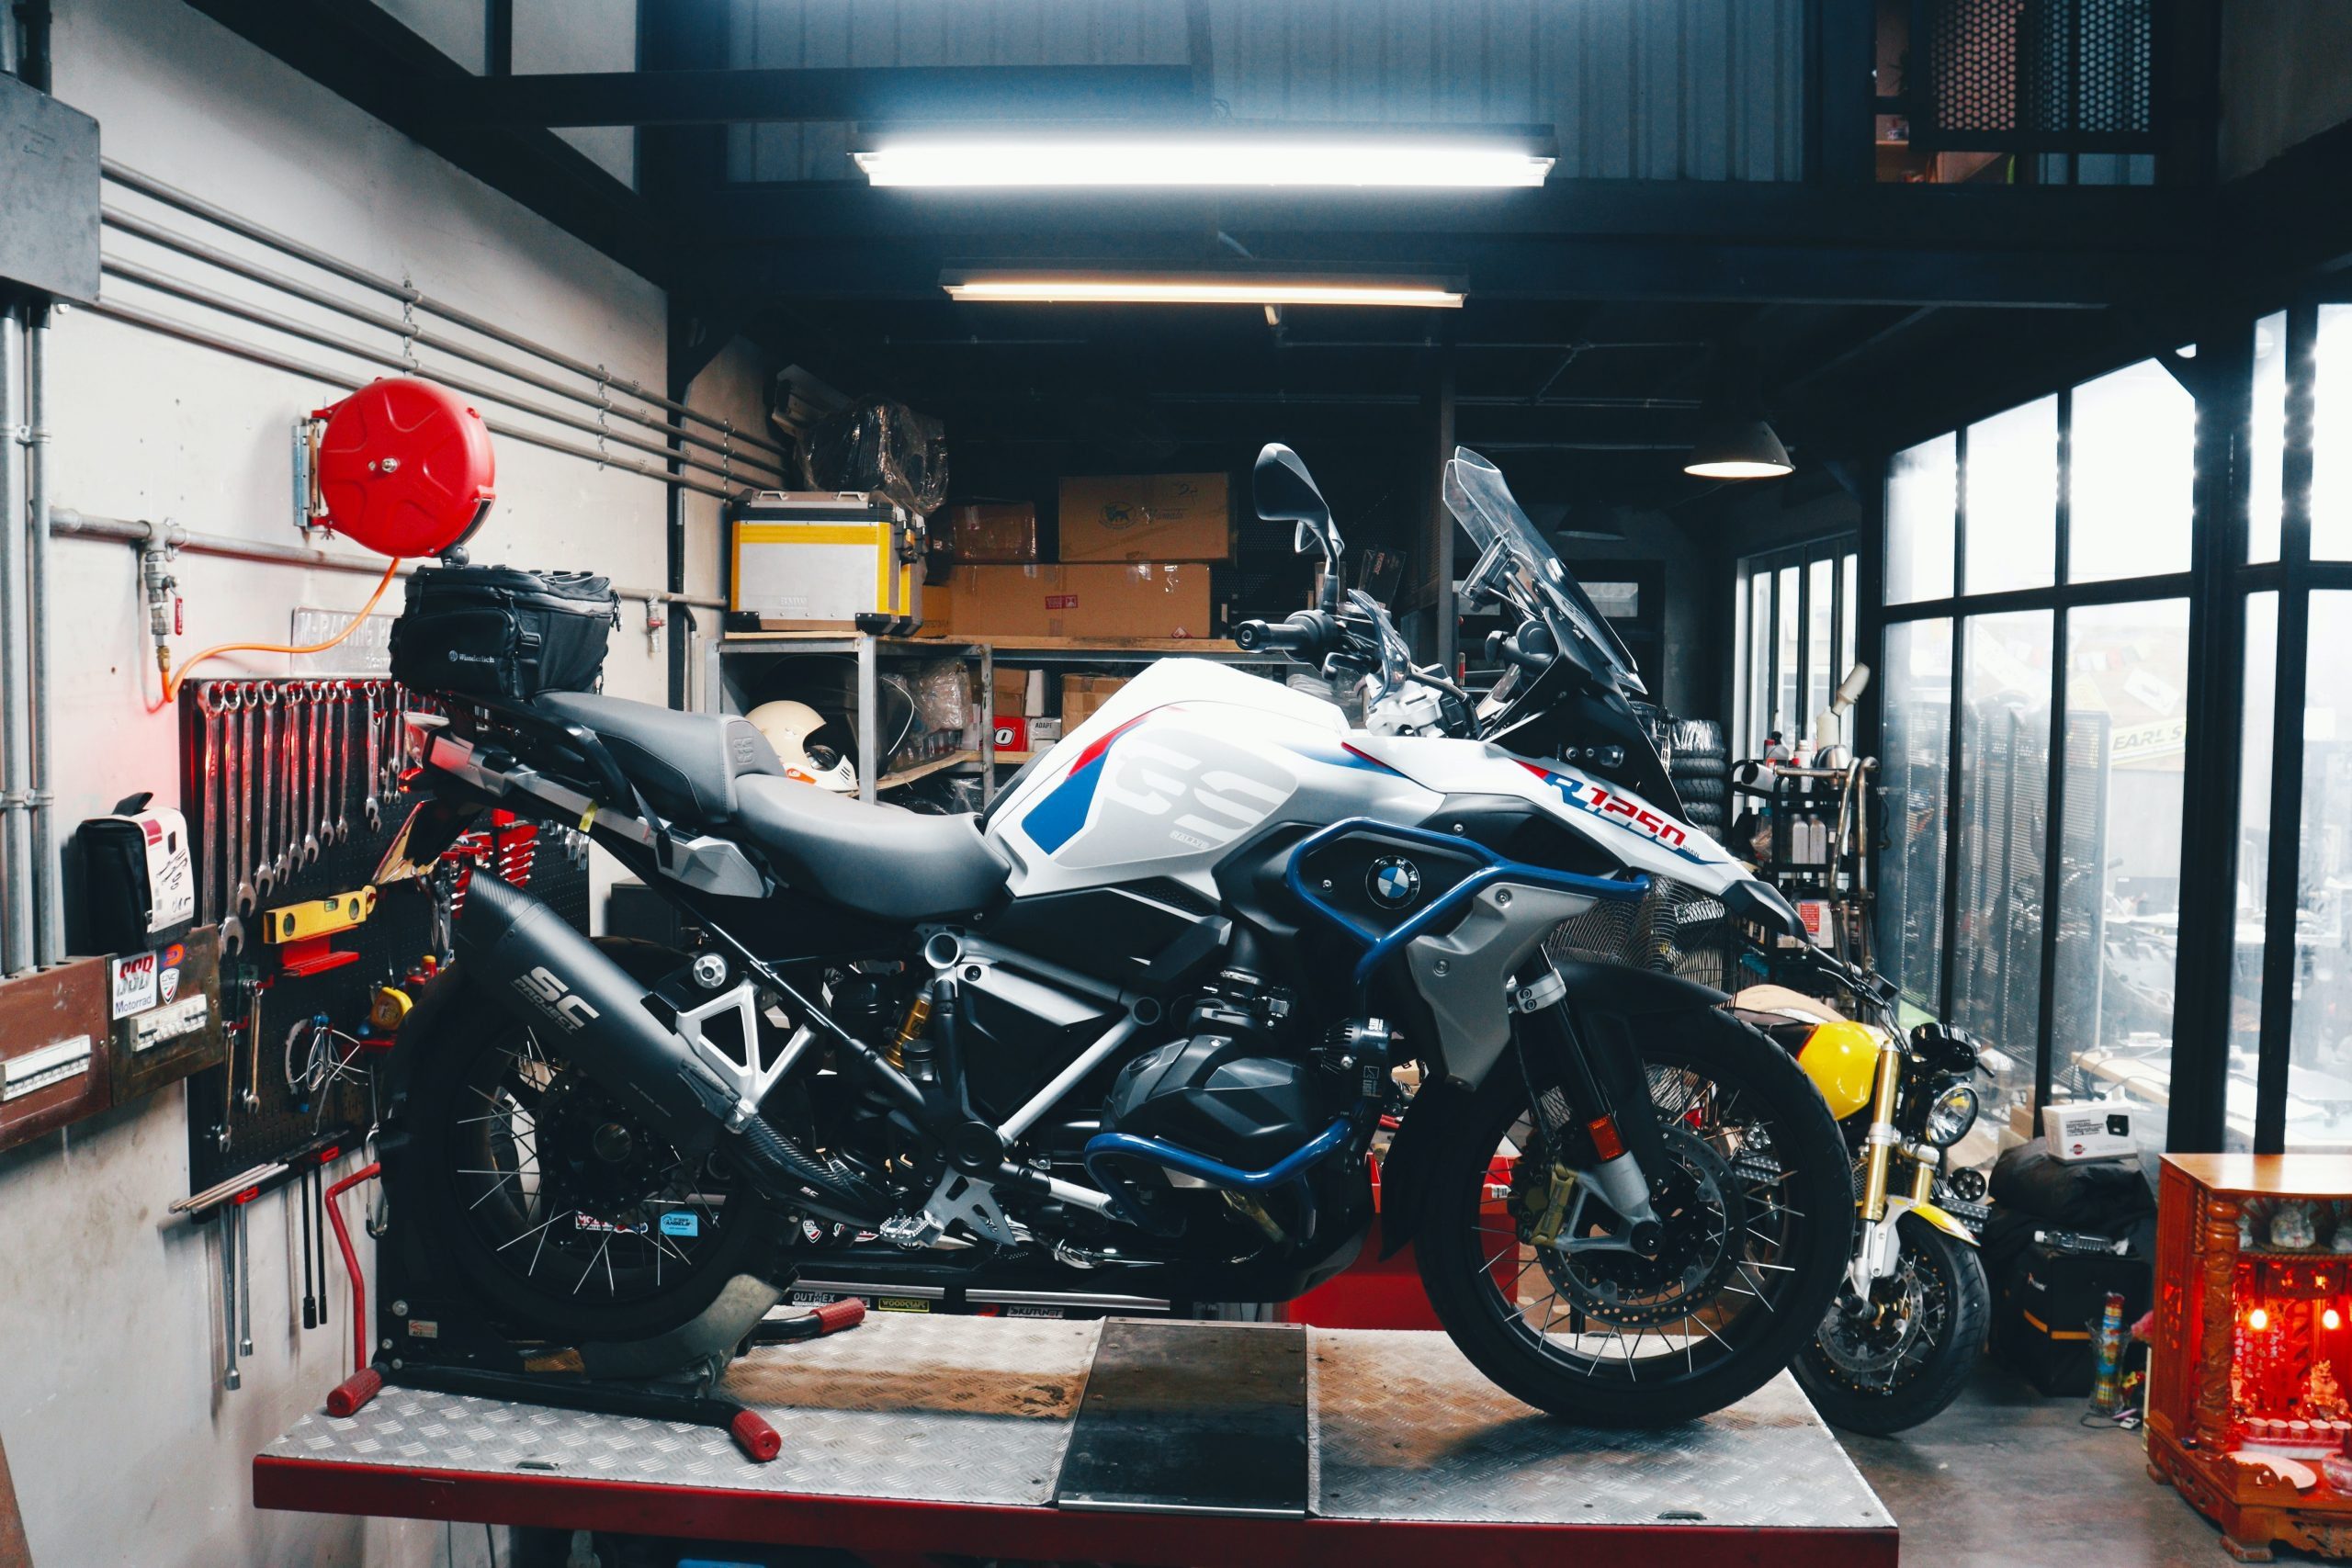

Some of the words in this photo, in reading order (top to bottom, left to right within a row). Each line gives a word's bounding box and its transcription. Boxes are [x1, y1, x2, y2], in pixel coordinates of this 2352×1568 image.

[459, 653, 495, 663] Wunderlich
[1682, 844, 1701, 859] BMW
[115, 995, 153, 1014] Motorrad
[514, 977, 580, 1031] PROJECT
[521, 966, 601, 1028] SC
